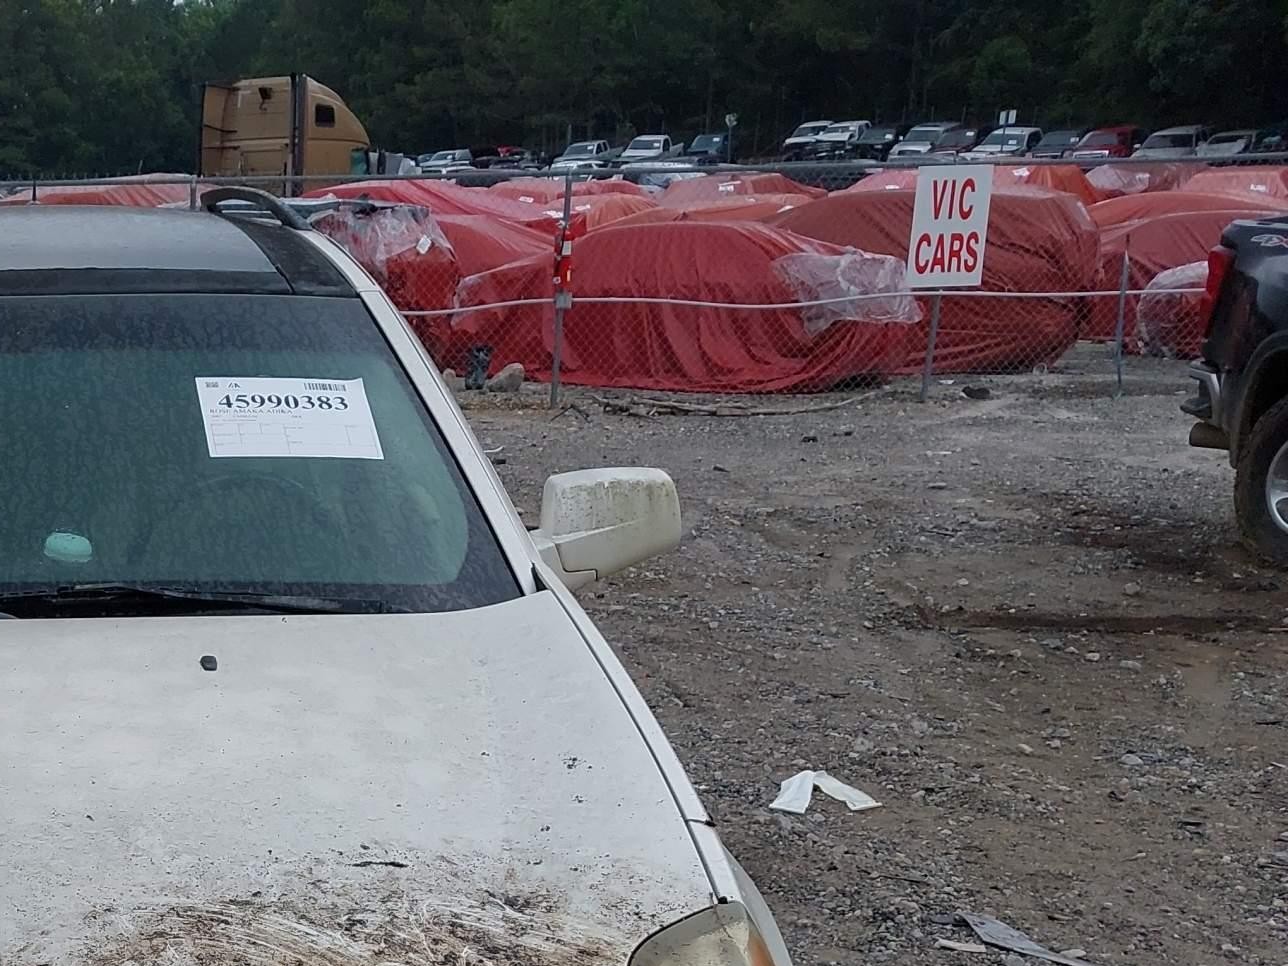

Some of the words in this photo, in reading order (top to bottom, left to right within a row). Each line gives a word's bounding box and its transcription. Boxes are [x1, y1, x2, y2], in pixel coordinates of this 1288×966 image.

[932, 178, 976, 220] VIC
[914, 231, 980, 275] CARS
[218, 394, 349, 411] 45990383
